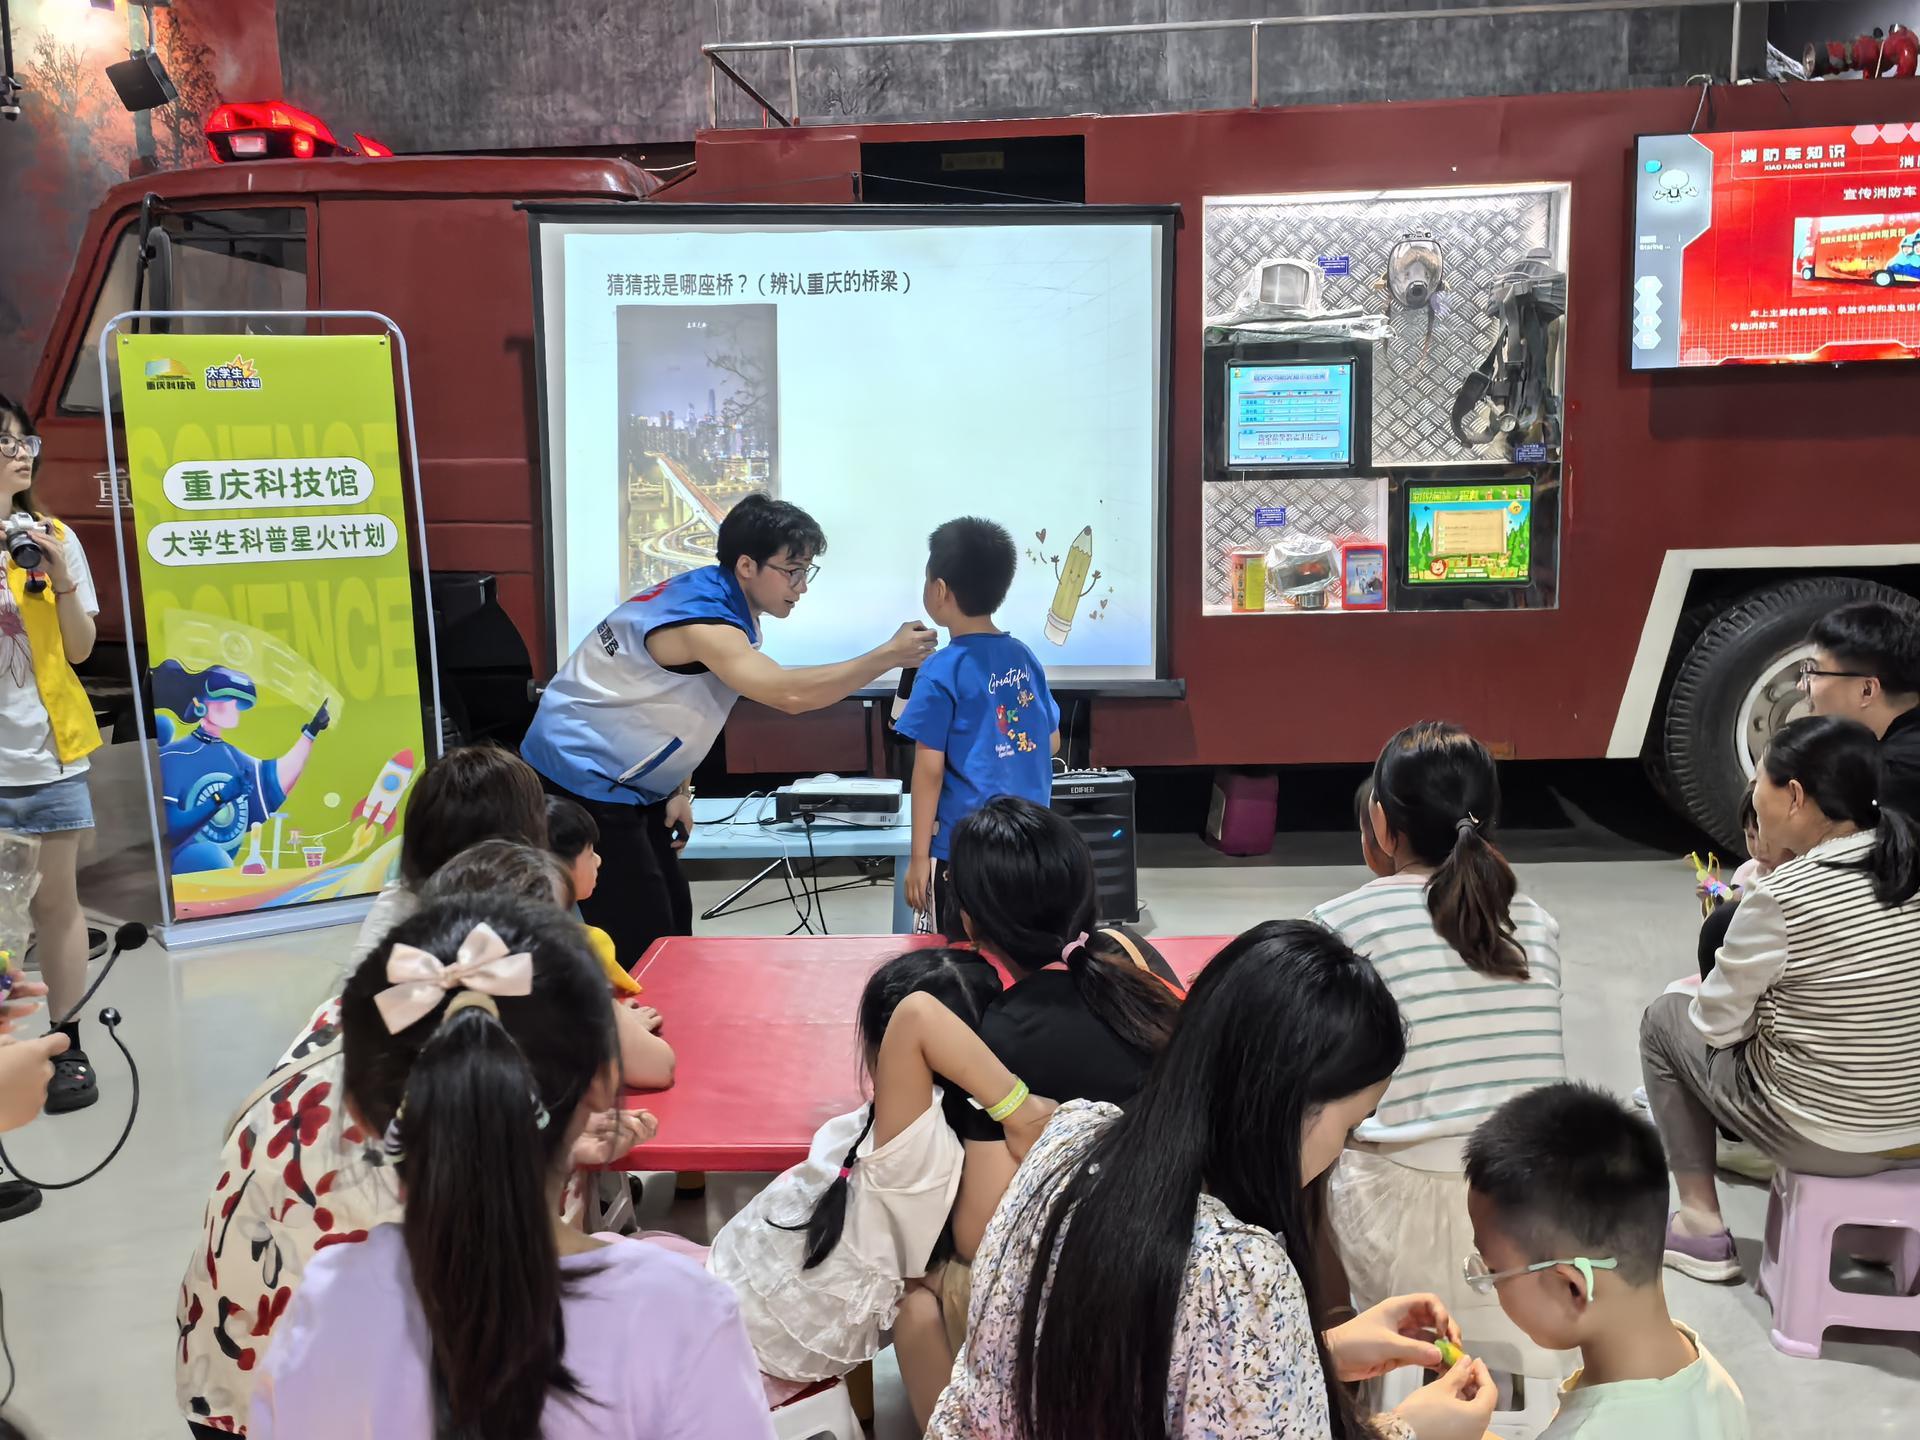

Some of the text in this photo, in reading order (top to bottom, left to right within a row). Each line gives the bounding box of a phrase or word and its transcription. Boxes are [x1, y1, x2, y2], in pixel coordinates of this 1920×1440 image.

[1741, 145, 1845, 163] 消防车知识
[1899, 155, 1920, 169] 消
[1843, 186, 1917, 201] 宣传消防车
[207, 367, 242, 379] 大学生
[181, 466, 359, 502] 重庆科技馆
[162, 523, 386, 557] 大学生科普星火计划
[1071, 786, 1095, 794] EDIFIER
